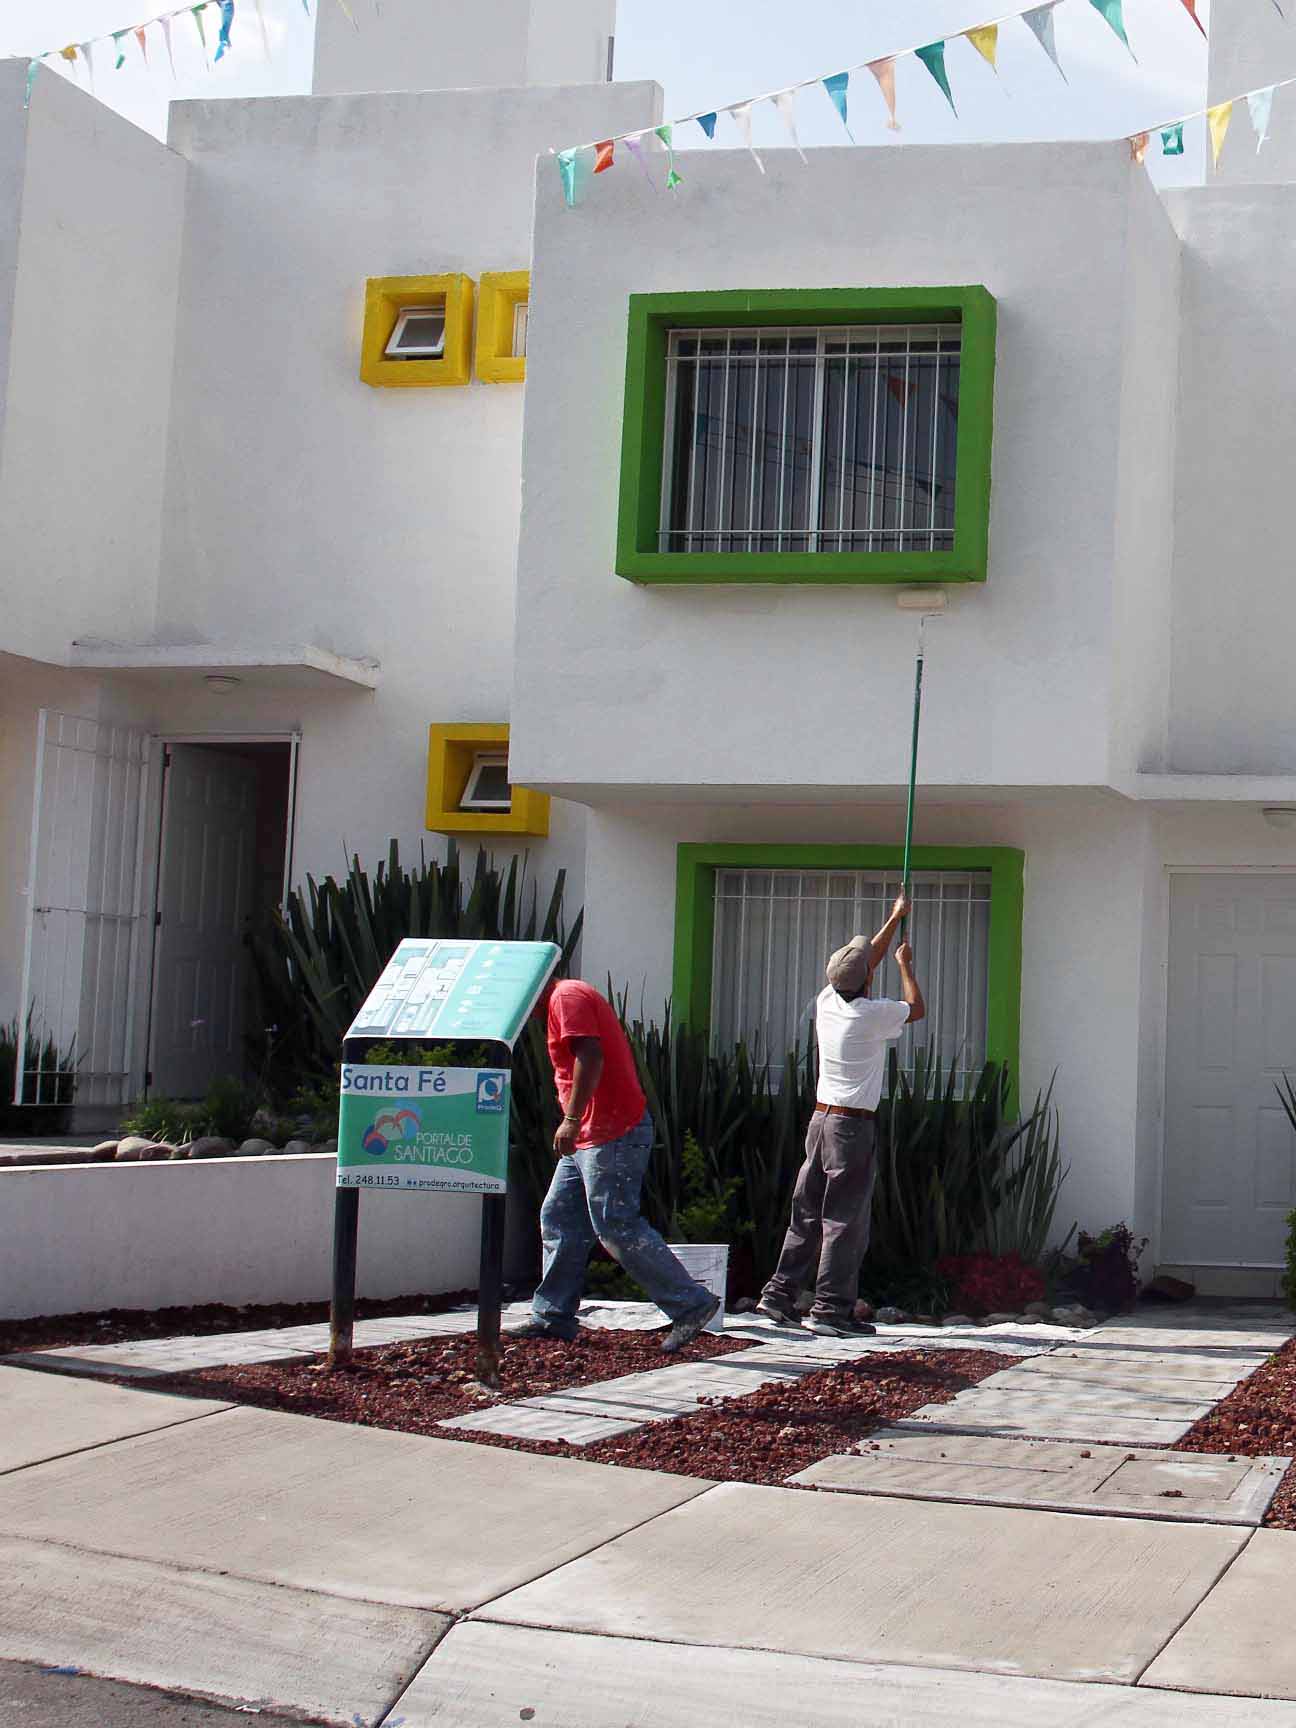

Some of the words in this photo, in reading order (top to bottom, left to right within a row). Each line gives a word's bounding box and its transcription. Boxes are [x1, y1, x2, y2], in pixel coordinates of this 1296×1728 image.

[342, 1068, 409, 1091] Santa
[418, 1070, 447, 1092] Fé
[416, 1132, 456, 1146] PORTAL
[457, 1134, 473, 1147] DE
[394, 1145, 474, 1164] SANTIAGO
[338, 1174, 353, 1186] Tel.
